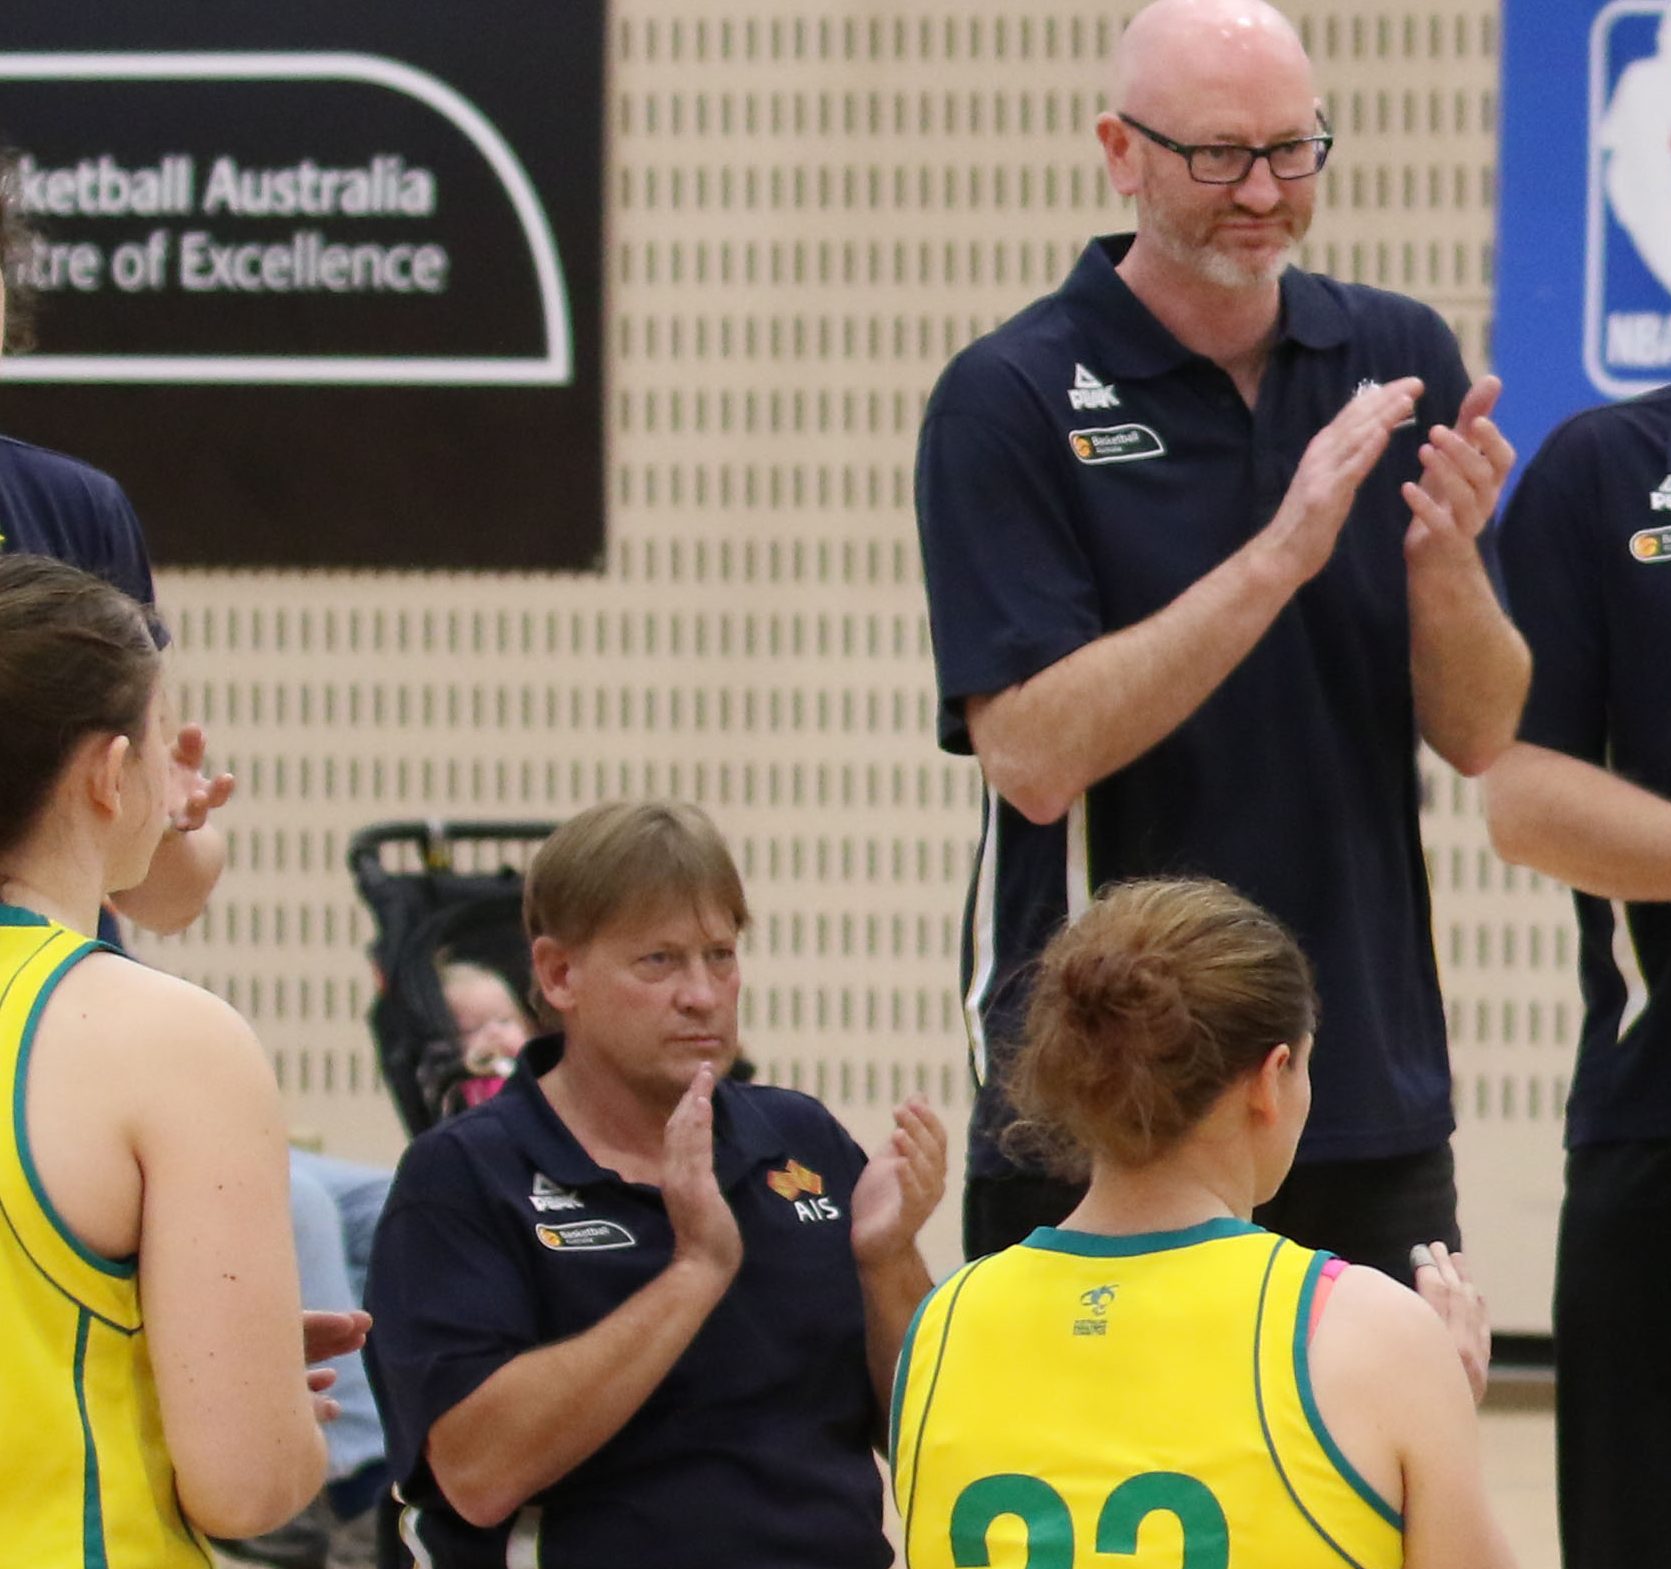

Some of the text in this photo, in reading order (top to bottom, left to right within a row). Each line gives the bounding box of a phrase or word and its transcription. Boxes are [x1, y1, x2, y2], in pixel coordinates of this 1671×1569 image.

[17, 153, 437, 217] ketball Australia
[18, 228, 449, 293] tre of Excellence
[794, 1196, 839, 1222] AIS
